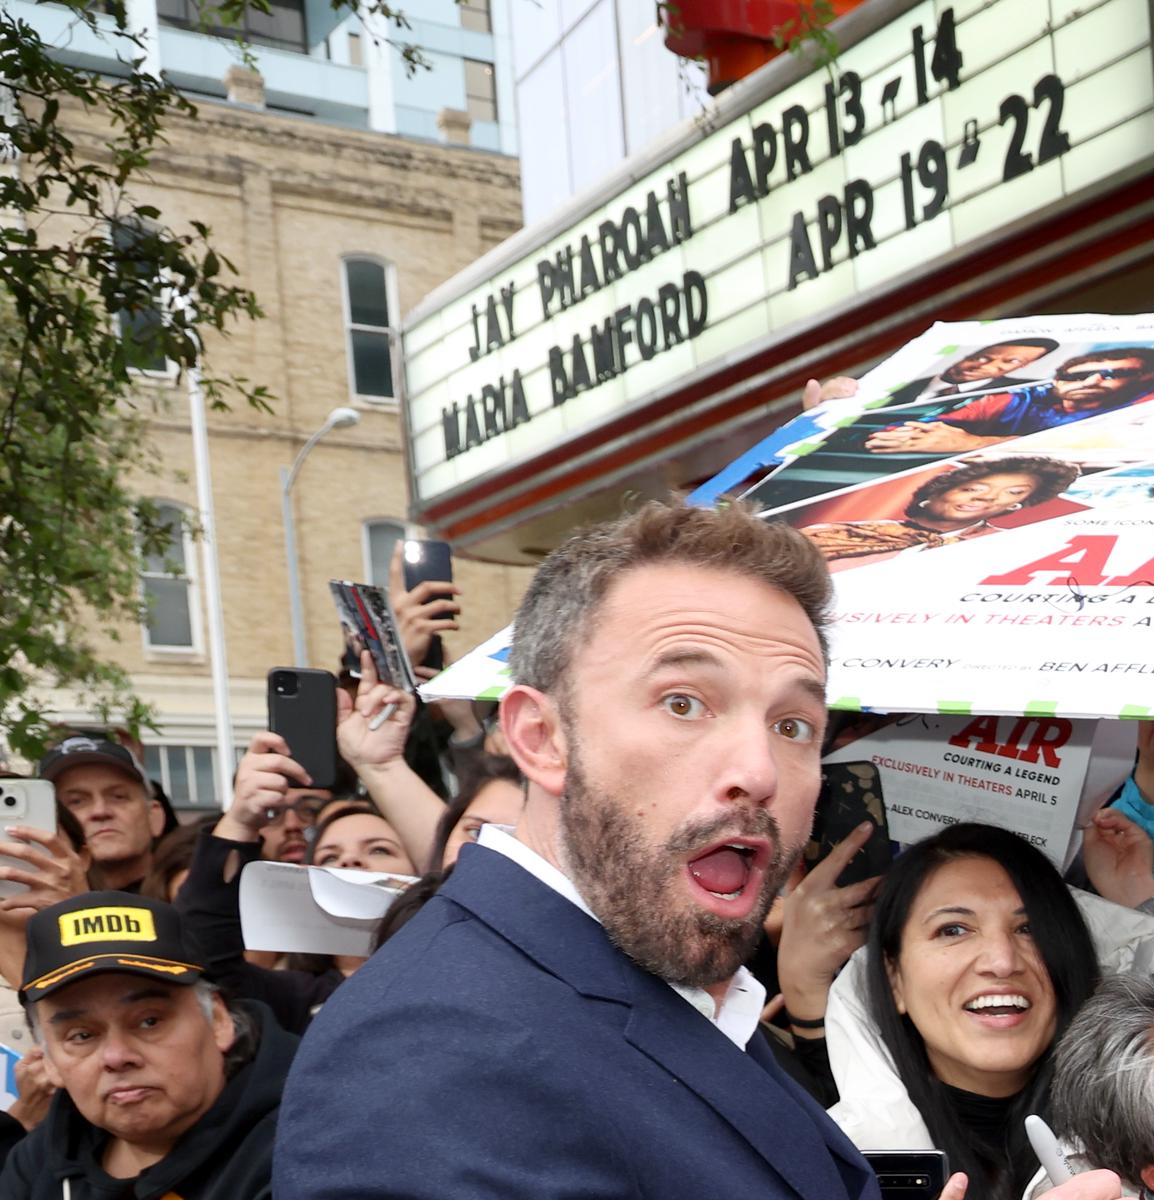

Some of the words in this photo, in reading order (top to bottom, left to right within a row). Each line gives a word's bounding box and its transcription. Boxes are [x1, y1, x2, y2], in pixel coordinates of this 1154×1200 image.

[468, 281, 515, 363] JAY
[537, 171, 692, 322] PHAROAH
[729, 104, 813, 215] APR
[442, 368, 531, 461] MARIA
[548, 270, 708, 407] BAMFORD
[788, 178, 877, 291] APR
[1063, 519, 1109, 527] SOME
[959, 592, 1111, 604] COURTING
[1116, 594, 1137, 604] A
[828, 611, 940, 625] USIVELY
[943, 613, 977, 625] IN
[984, 614, 1128, 627] THEATERS
[841, 657, 962, 669] CONVERY
[1038, 661, 1089, 673] BEN
[948, 716, 1073, 769] AIR
[871, 755, 941, 781] EXCLUSIVELY
[943, 770, 955, 783] IN
[957, 775, 1014, 797] THEATERS
[1015, 788, 1048, 804] APRIL
[1050, 795, 1058, 806] 5
[943, 752, 1001, 773] COURTING
[1004, 765, 1012, 776] A
[1015, 768, 1061, 787] LEGEND
[891, 804, 914, 817] ALEX
[915, 808, 961, 826] CONVERY
[73, 914, 141, 936] IMDb
